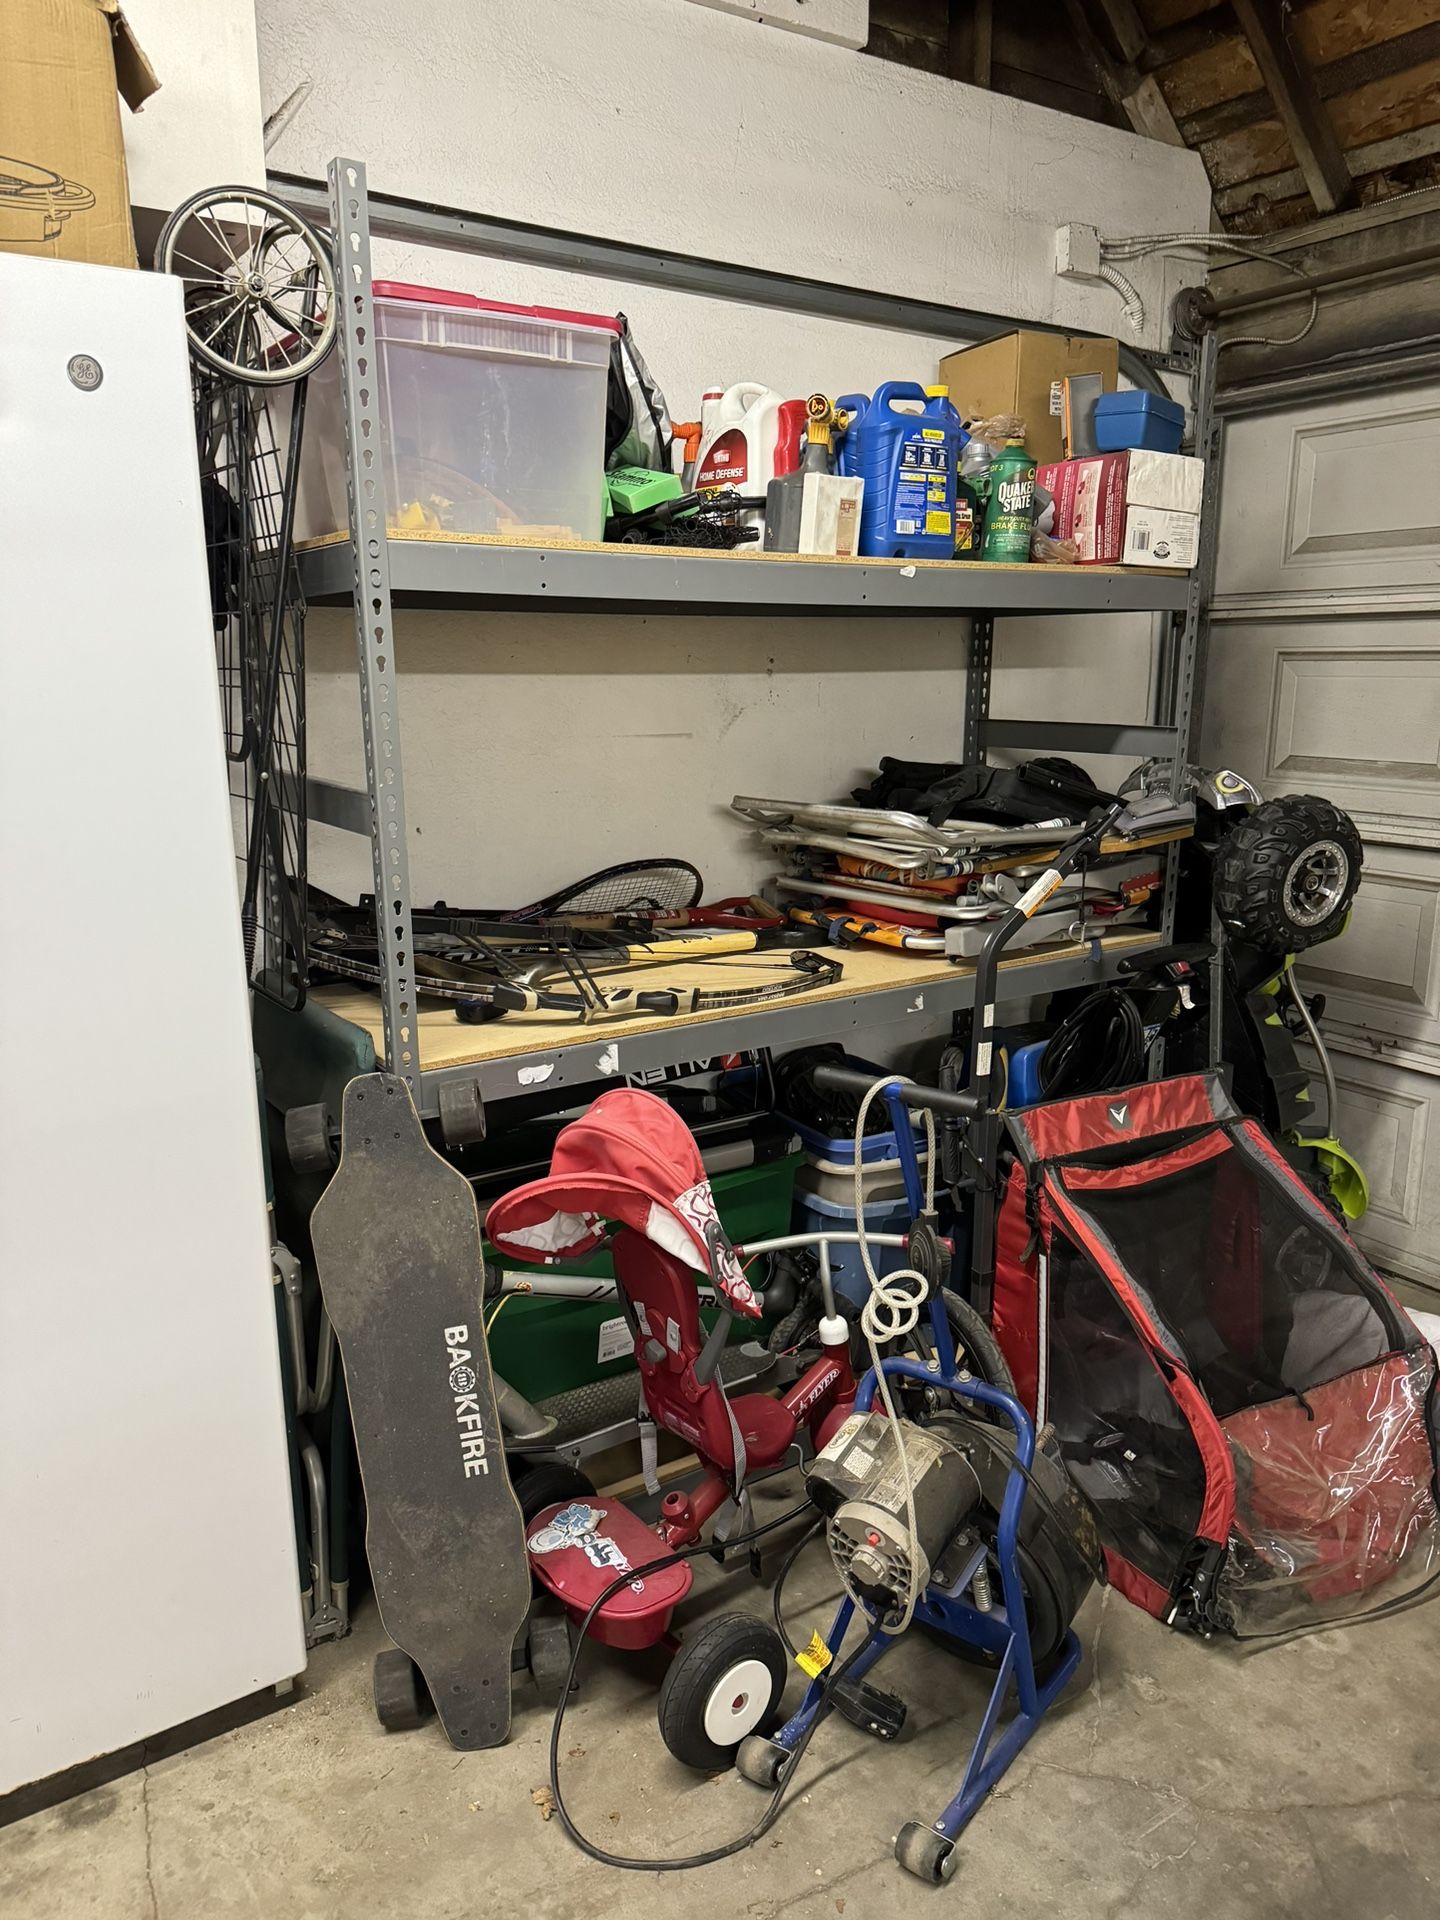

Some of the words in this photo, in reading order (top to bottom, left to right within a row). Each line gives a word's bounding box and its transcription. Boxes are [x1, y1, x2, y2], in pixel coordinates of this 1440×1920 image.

[700, 471, 715, 482] HOME
[715, 467, 744, 480] DEFENSE
[1003, 494, 1031, 513] STATE
[625, 1058, 711, 1088] ALLEN
[808, 1370, 840, 1403] FLYER
